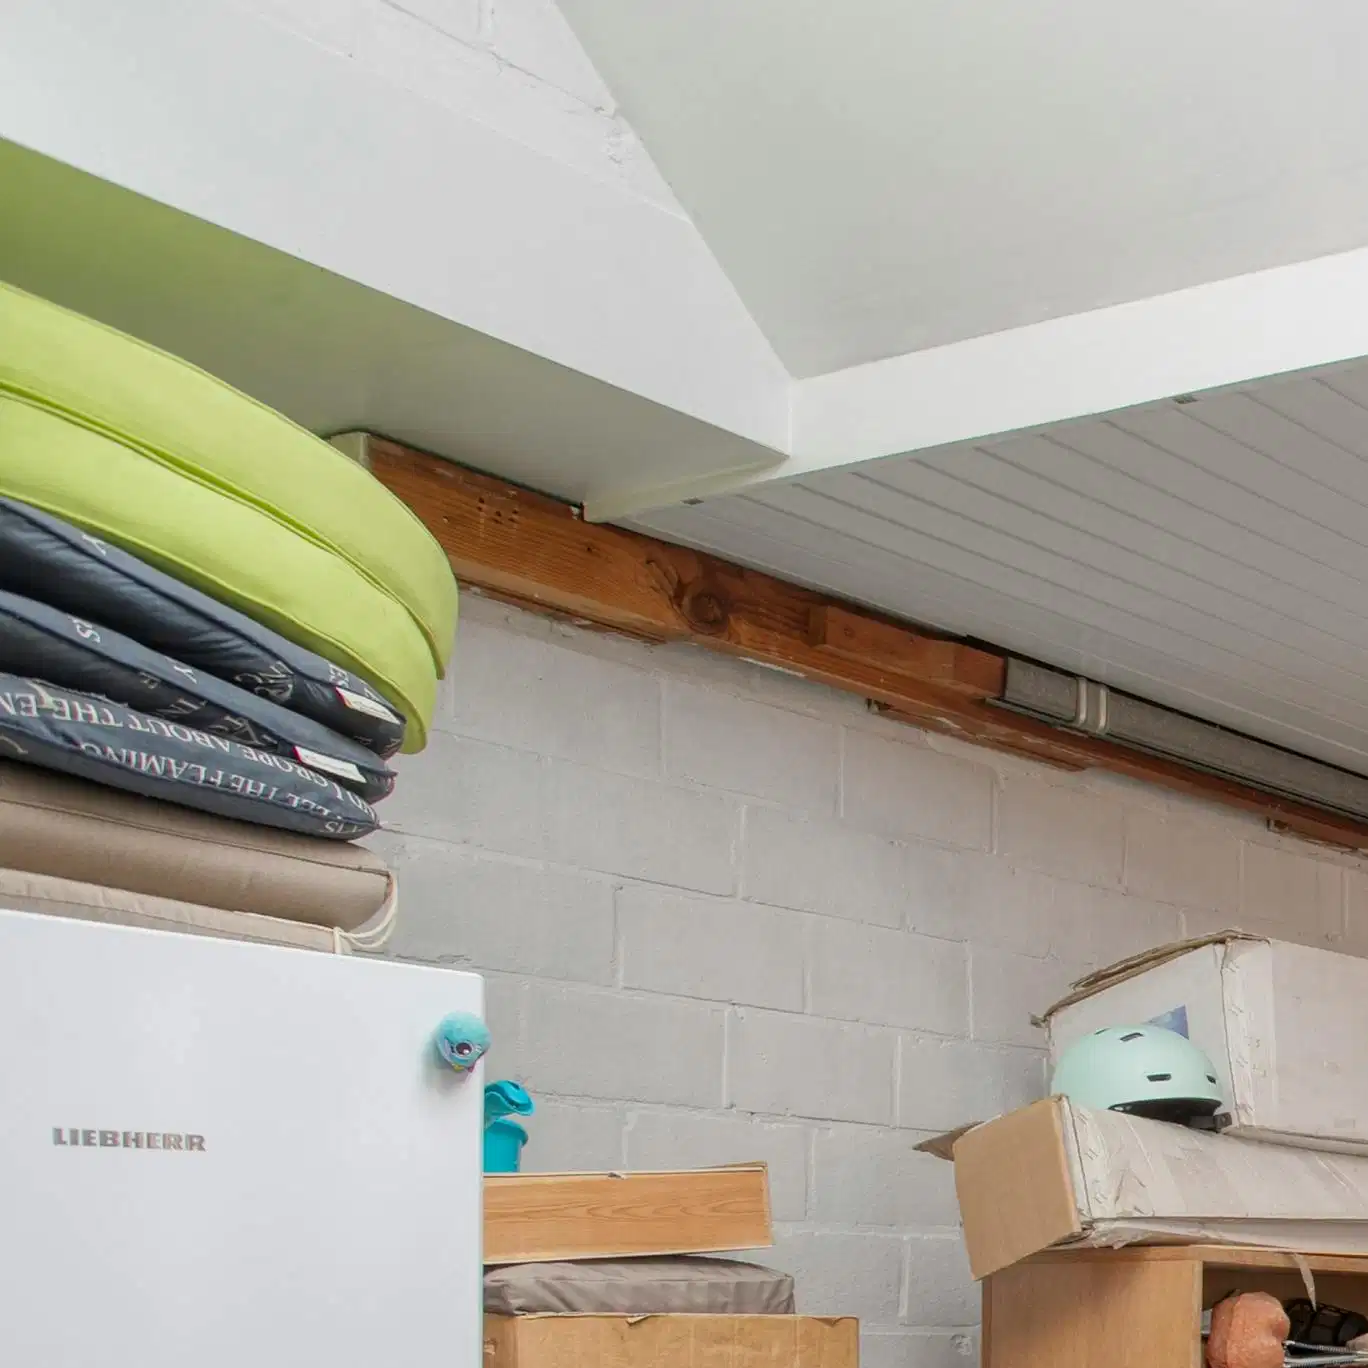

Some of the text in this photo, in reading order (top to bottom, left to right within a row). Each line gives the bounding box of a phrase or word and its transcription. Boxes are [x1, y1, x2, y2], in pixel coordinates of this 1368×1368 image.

[52, 697, 124, 727] THE
[127, 713, 231, 753] ABOUT
[230, 774, 280, 801] THE
[52, 1127, 206, 1152] LIEBHERR
